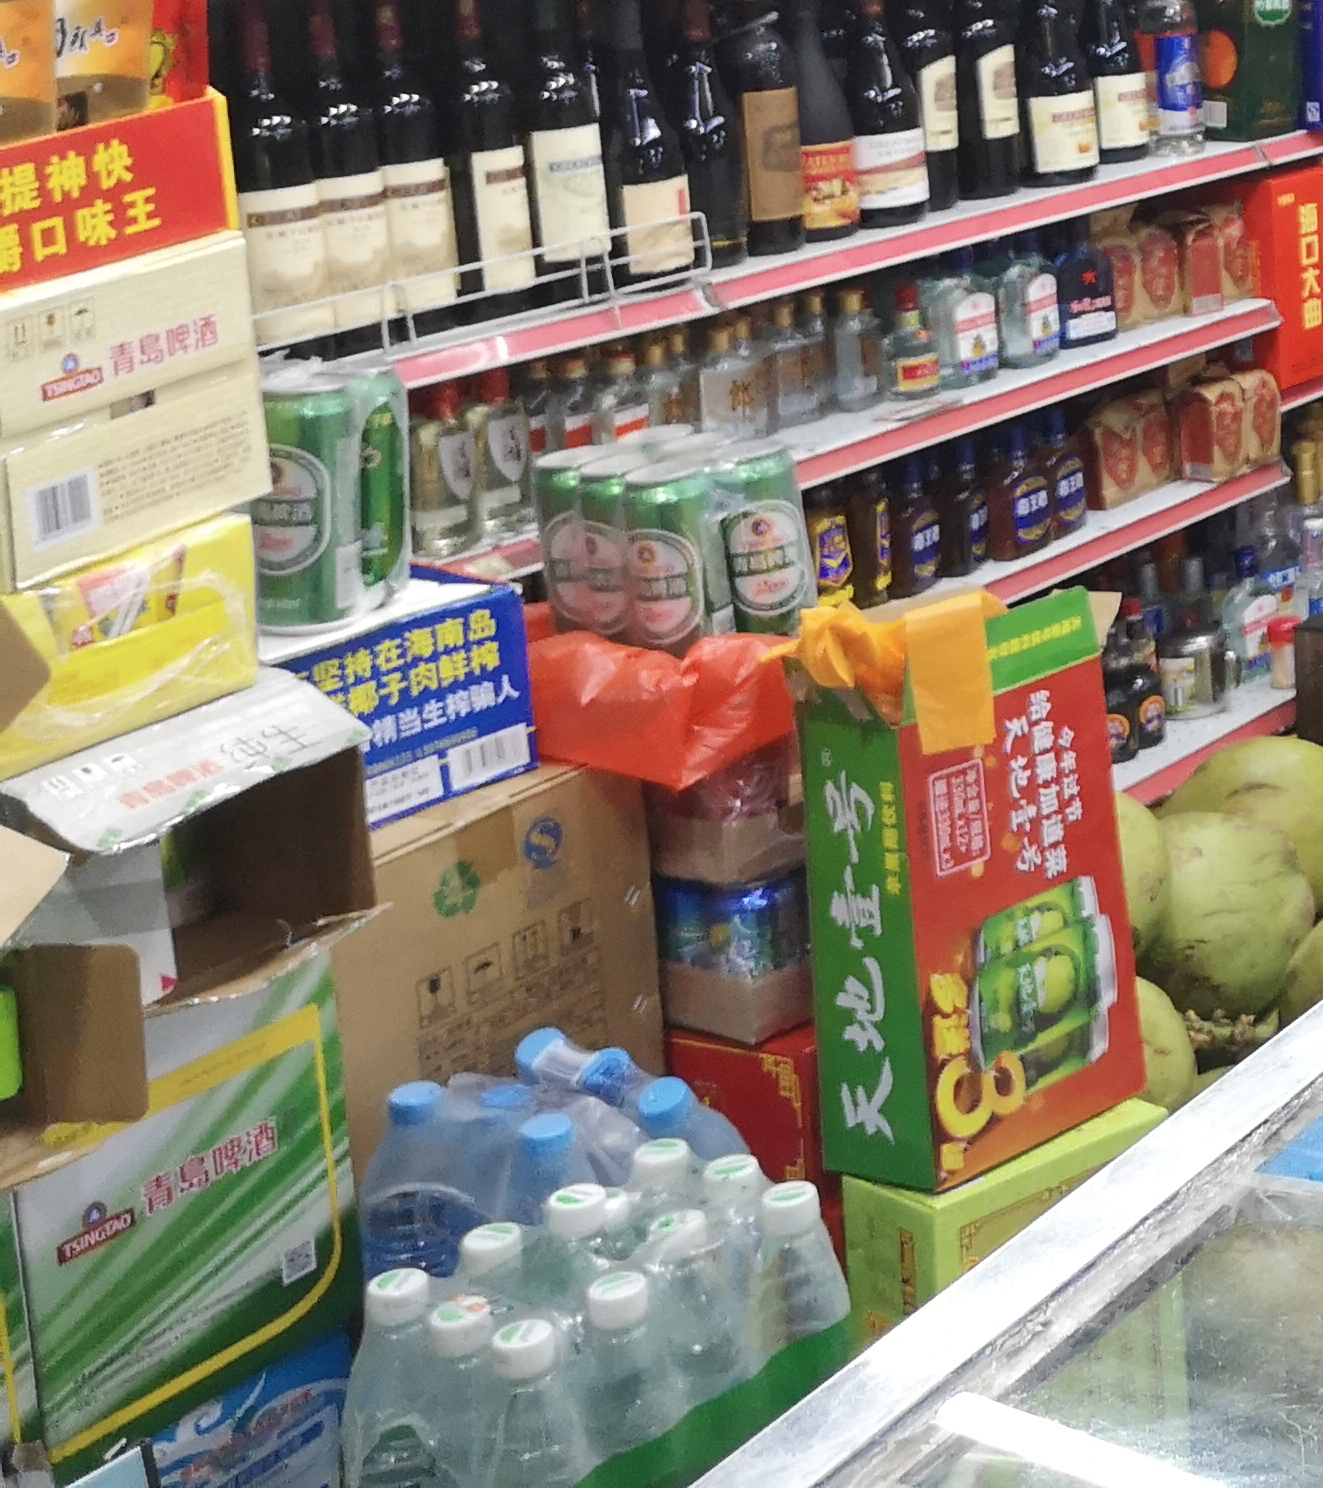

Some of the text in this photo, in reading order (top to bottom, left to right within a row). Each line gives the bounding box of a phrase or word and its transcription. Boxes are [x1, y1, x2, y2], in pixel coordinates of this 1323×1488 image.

[109, 314, 218, 376] 青岛啤酒
[296, 608, 497, 693] 坚持在海南岛
[360, 673, 521, 753] 精当生榨骗人
[1003, 715, 1042, 873] 天地壹号
[1028, 688, 1068, 880] 给健康加道菜
[824, 769, 895, 1145] 天地壹号
[141, 1119, 279, 1217] 青岛啤酒
[63, 1211, 133, 1260] TSINGTAO
